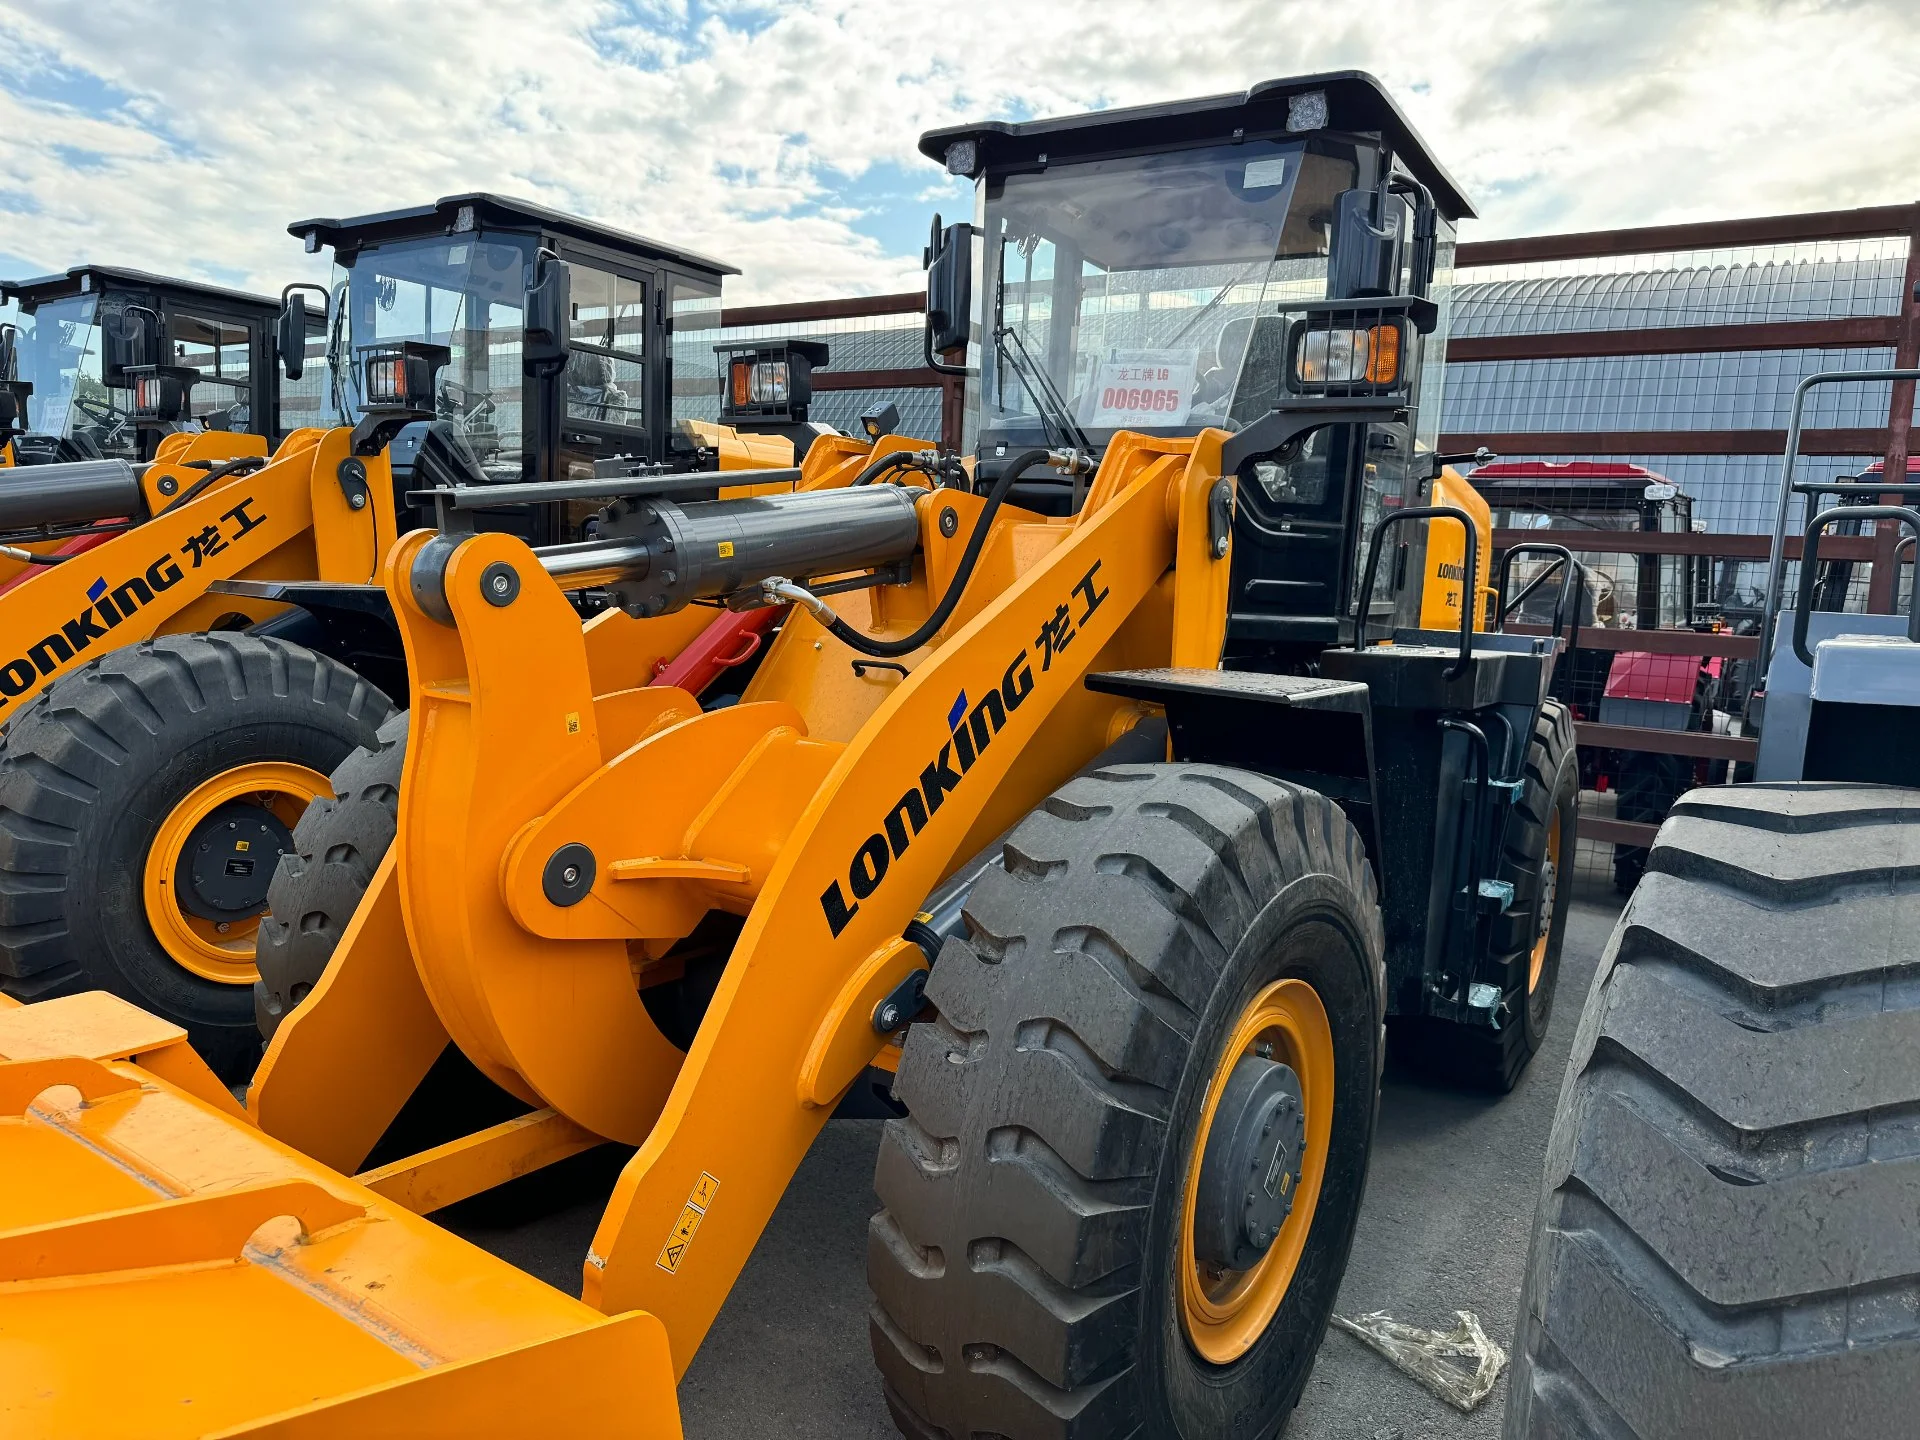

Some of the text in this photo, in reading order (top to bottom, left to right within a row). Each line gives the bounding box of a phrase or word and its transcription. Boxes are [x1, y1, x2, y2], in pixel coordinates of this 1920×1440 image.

[1117, 367, 1154, 381] 龙工牌
[1102, 388, 1179, 411] 006965
[0, 553, 185, 708] ONKING
